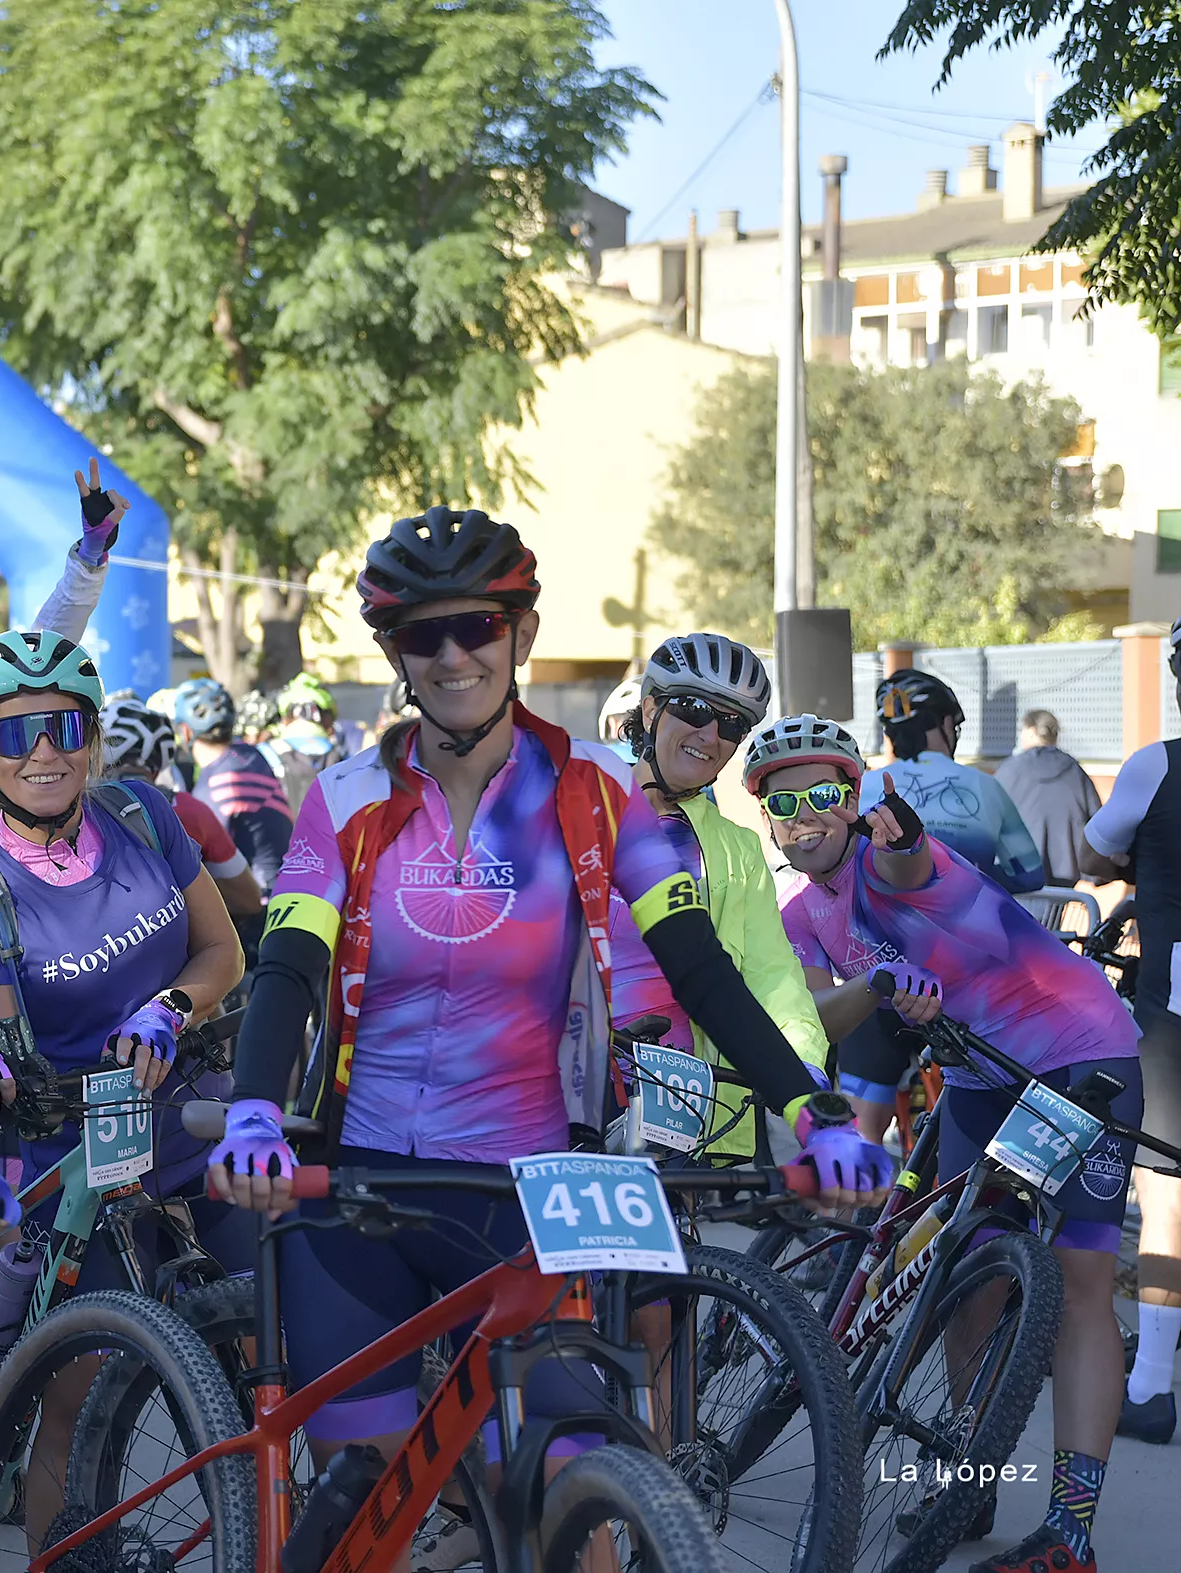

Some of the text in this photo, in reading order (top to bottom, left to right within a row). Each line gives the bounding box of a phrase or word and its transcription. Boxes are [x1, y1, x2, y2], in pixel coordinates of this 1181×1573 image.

[669, 641, 688, 667] SCOTT
[399, 866, 515, 886] BUKARDAS
[669, 880, 701, 912] S
[42, 885, 186, 984] #Soybukard
[641, 1050, 708, 1075] BTTASPANOA
[90, 1074, 133, 1094] BTTASP
[654, 1069, 703, 1117] 108
[665, 1117, 684, 1130] PILAR
[1027, 1116, 1080, 1162] 44
[521, 1160, 647, 1179] BTTASPANOA
[1022, 1150, 1050, 1172] SIRESA
[541, 1181, 654, 1228] 416
[578, 1235, 638, 1247] PATRICIA
[692, 1264, 770, 1311] MAXXIS
